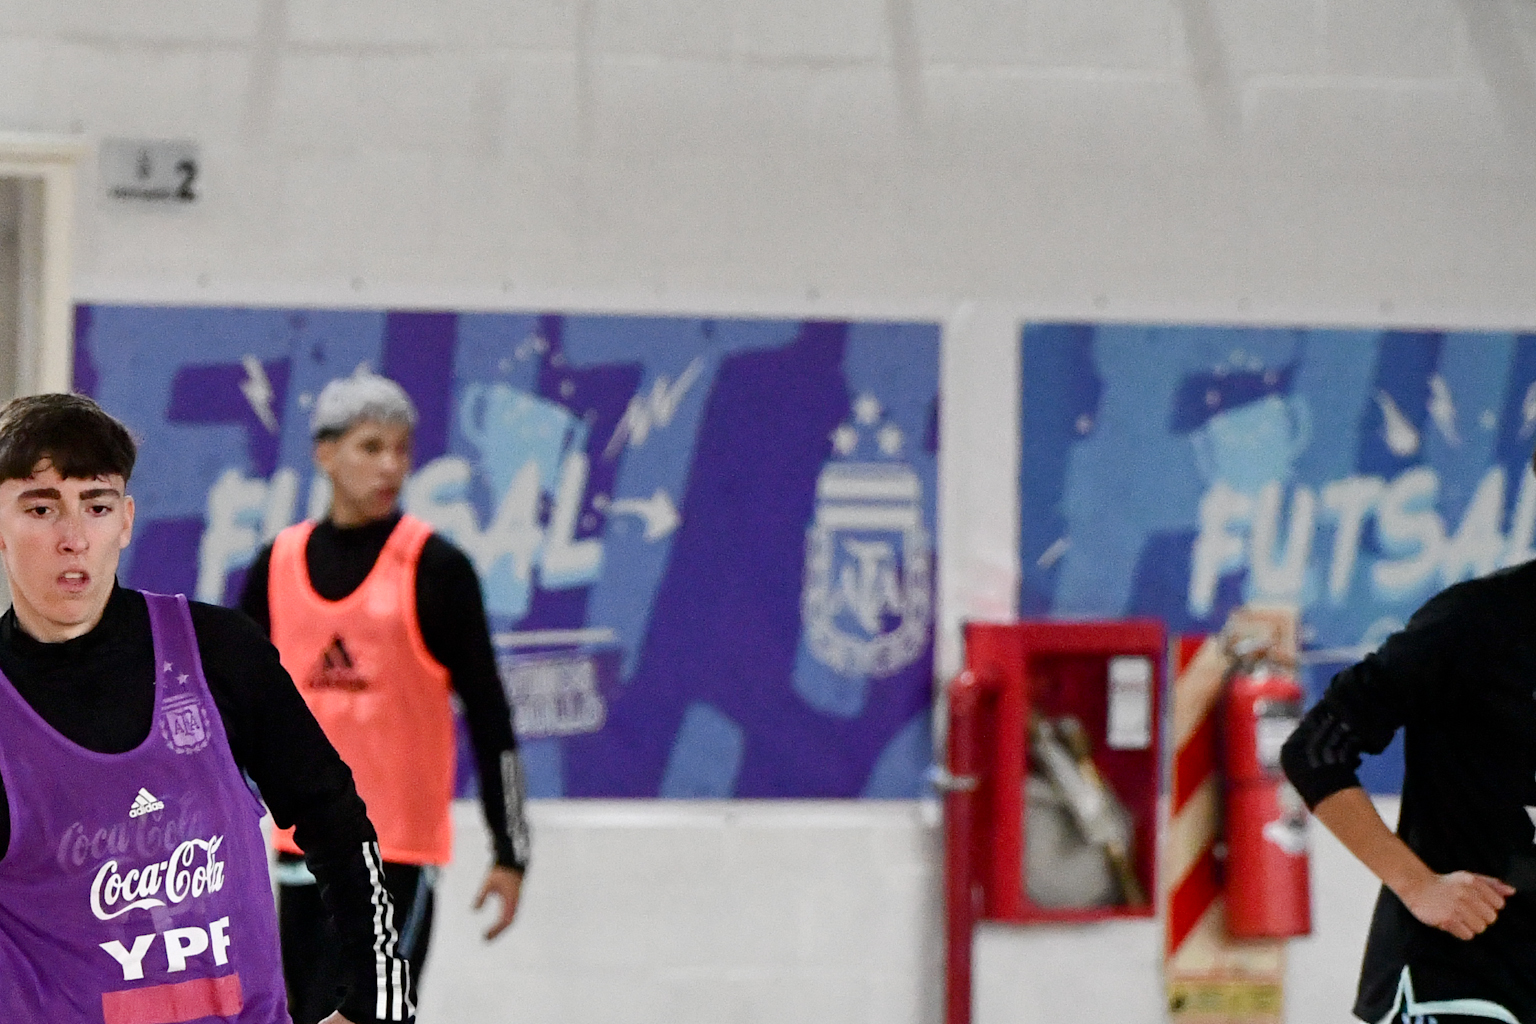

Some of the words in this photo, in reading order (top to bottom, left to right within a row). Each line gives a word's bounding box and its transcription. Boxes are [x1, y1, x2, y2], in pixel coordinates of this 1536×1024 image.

[173, 159, 198, 200] 2
[129, 801, 164, 819] adidas
[90, 835, 225, 920] Coca-Cola
[98, 915, 231, 981] YPF
